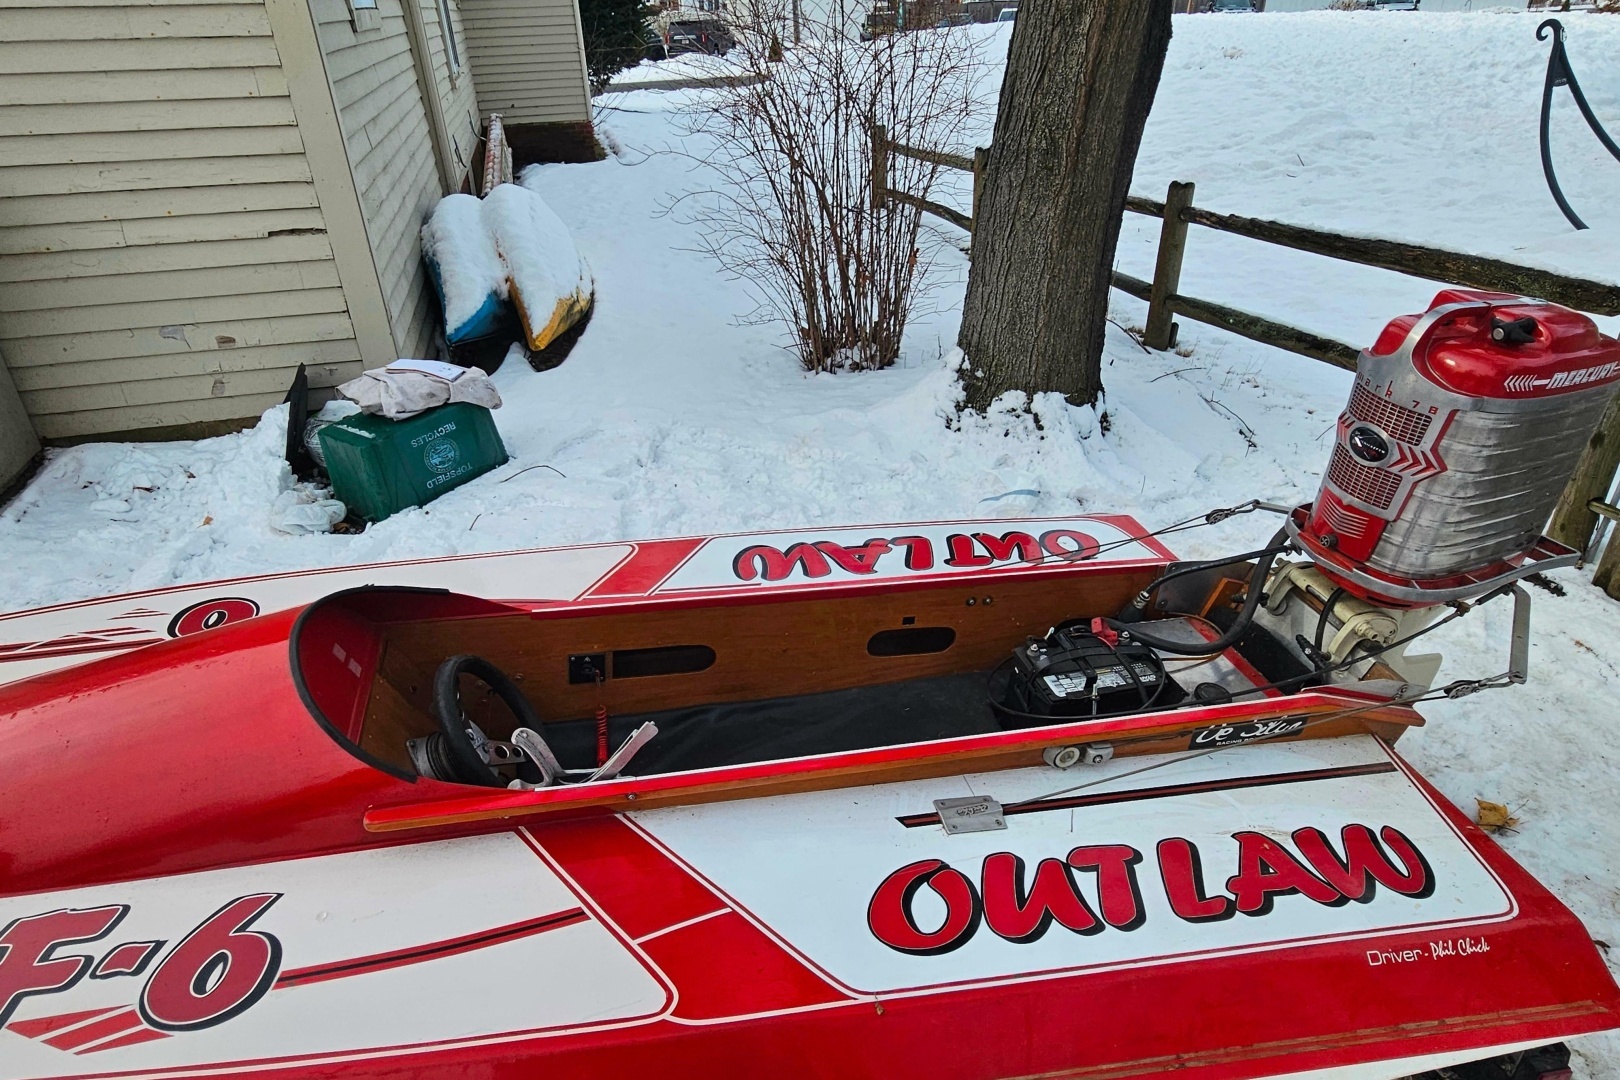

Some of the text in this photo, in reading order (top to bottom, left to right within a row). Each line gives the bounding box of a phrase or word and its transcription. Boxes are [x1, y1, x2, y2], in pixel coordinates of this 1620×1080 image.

[1546, 361, 1618, 390] MERCURY
[411, 421, 456, 448] RECYCLES
[426, 462, 473, 489] TOPSFIELD
[867, 823, 1435, 956] OUTLAW
